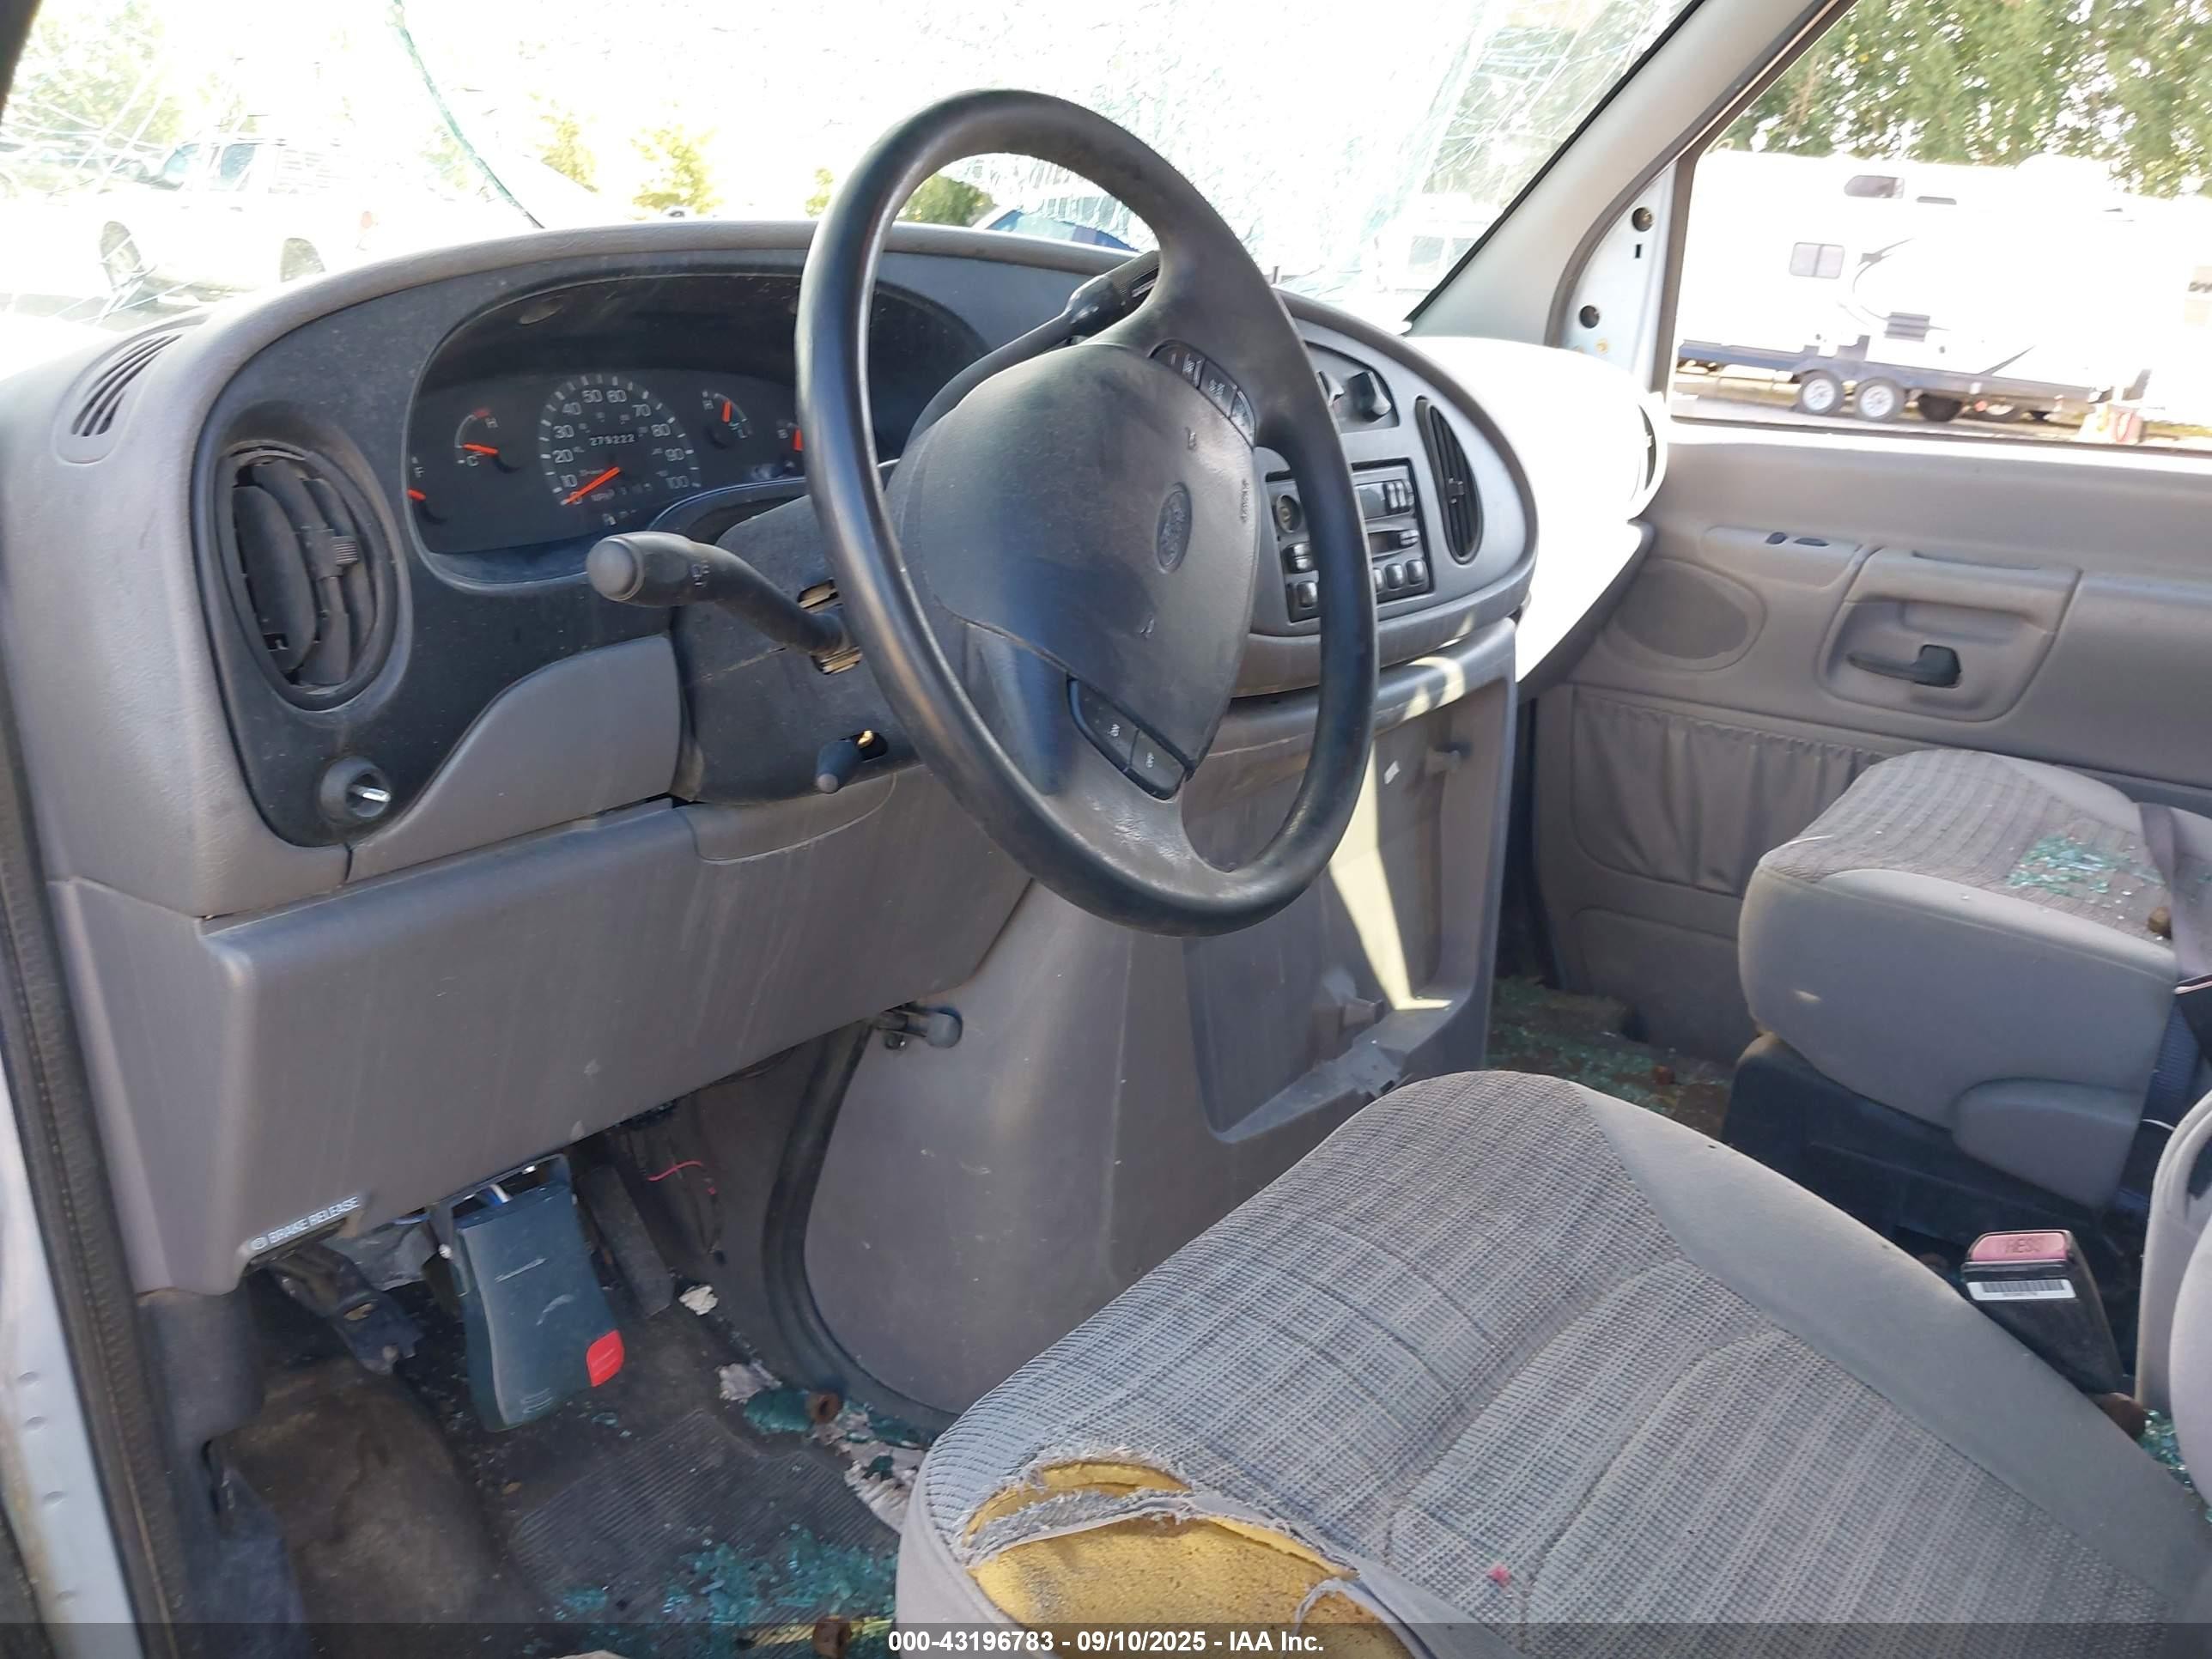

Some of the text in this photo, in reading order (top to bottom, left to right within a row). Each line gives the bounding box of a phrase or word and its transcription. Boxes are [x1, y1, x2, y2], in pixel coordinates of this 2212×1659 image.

[582, 389, 603, 403] 50
[606, 389, 627, 403] 60
[562, 402, 582, 416] 40
[632, 404, 652, 417] 70
[554, 424, 574, 439] 30
[553, 449, 574, 464] 20
[665, 448, 685, 462] 90
[561, 474, 578, 488] 10
[665, 475, 690, 489] 100
[267, 1196, 360, 1243] BRAKE RELEASE
